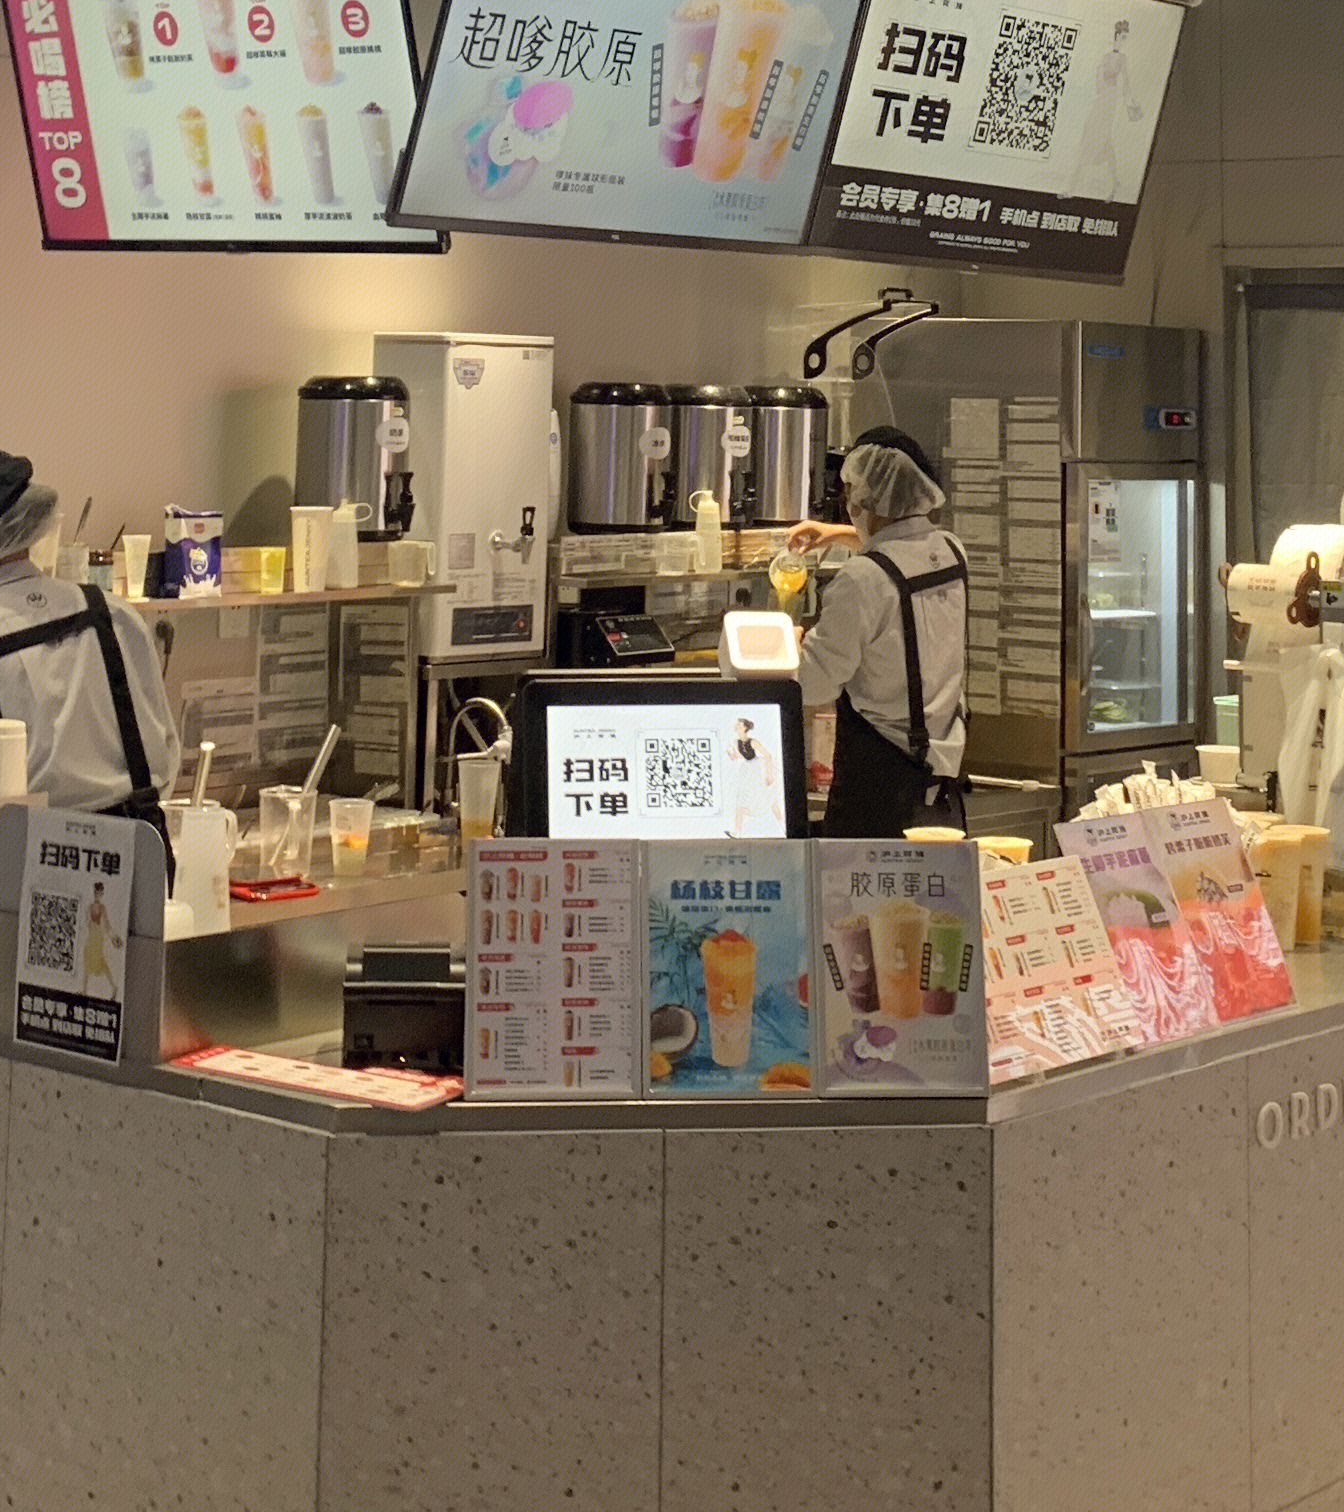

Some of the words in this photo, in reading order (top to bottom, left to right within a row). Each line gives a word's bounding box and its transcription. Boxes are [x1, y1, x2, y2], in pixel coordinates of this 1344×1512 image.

[158, 17, 173, 40] 1
[253, 13, 271, 36] 2
[346, 7, 364, 31] 3
[449, 6, 644, 87] 超嗲胶原
[876, 21, 967, 83] 扫码
[871, 88, 952, 145] 下单
[39, 130, 82, 151] TOP
[52, 157, 87, 208] 8
[1000, 207, 1040, 229] 手机点
[1040, 212, 1081, 232] 到店取
[562, 757, 629, 783] 扫码
[565, 792, 629, 817] 下单
[39, 840, 122, 877] 扫码下单
[849, 872, 946, 898] 胶原蛋白
